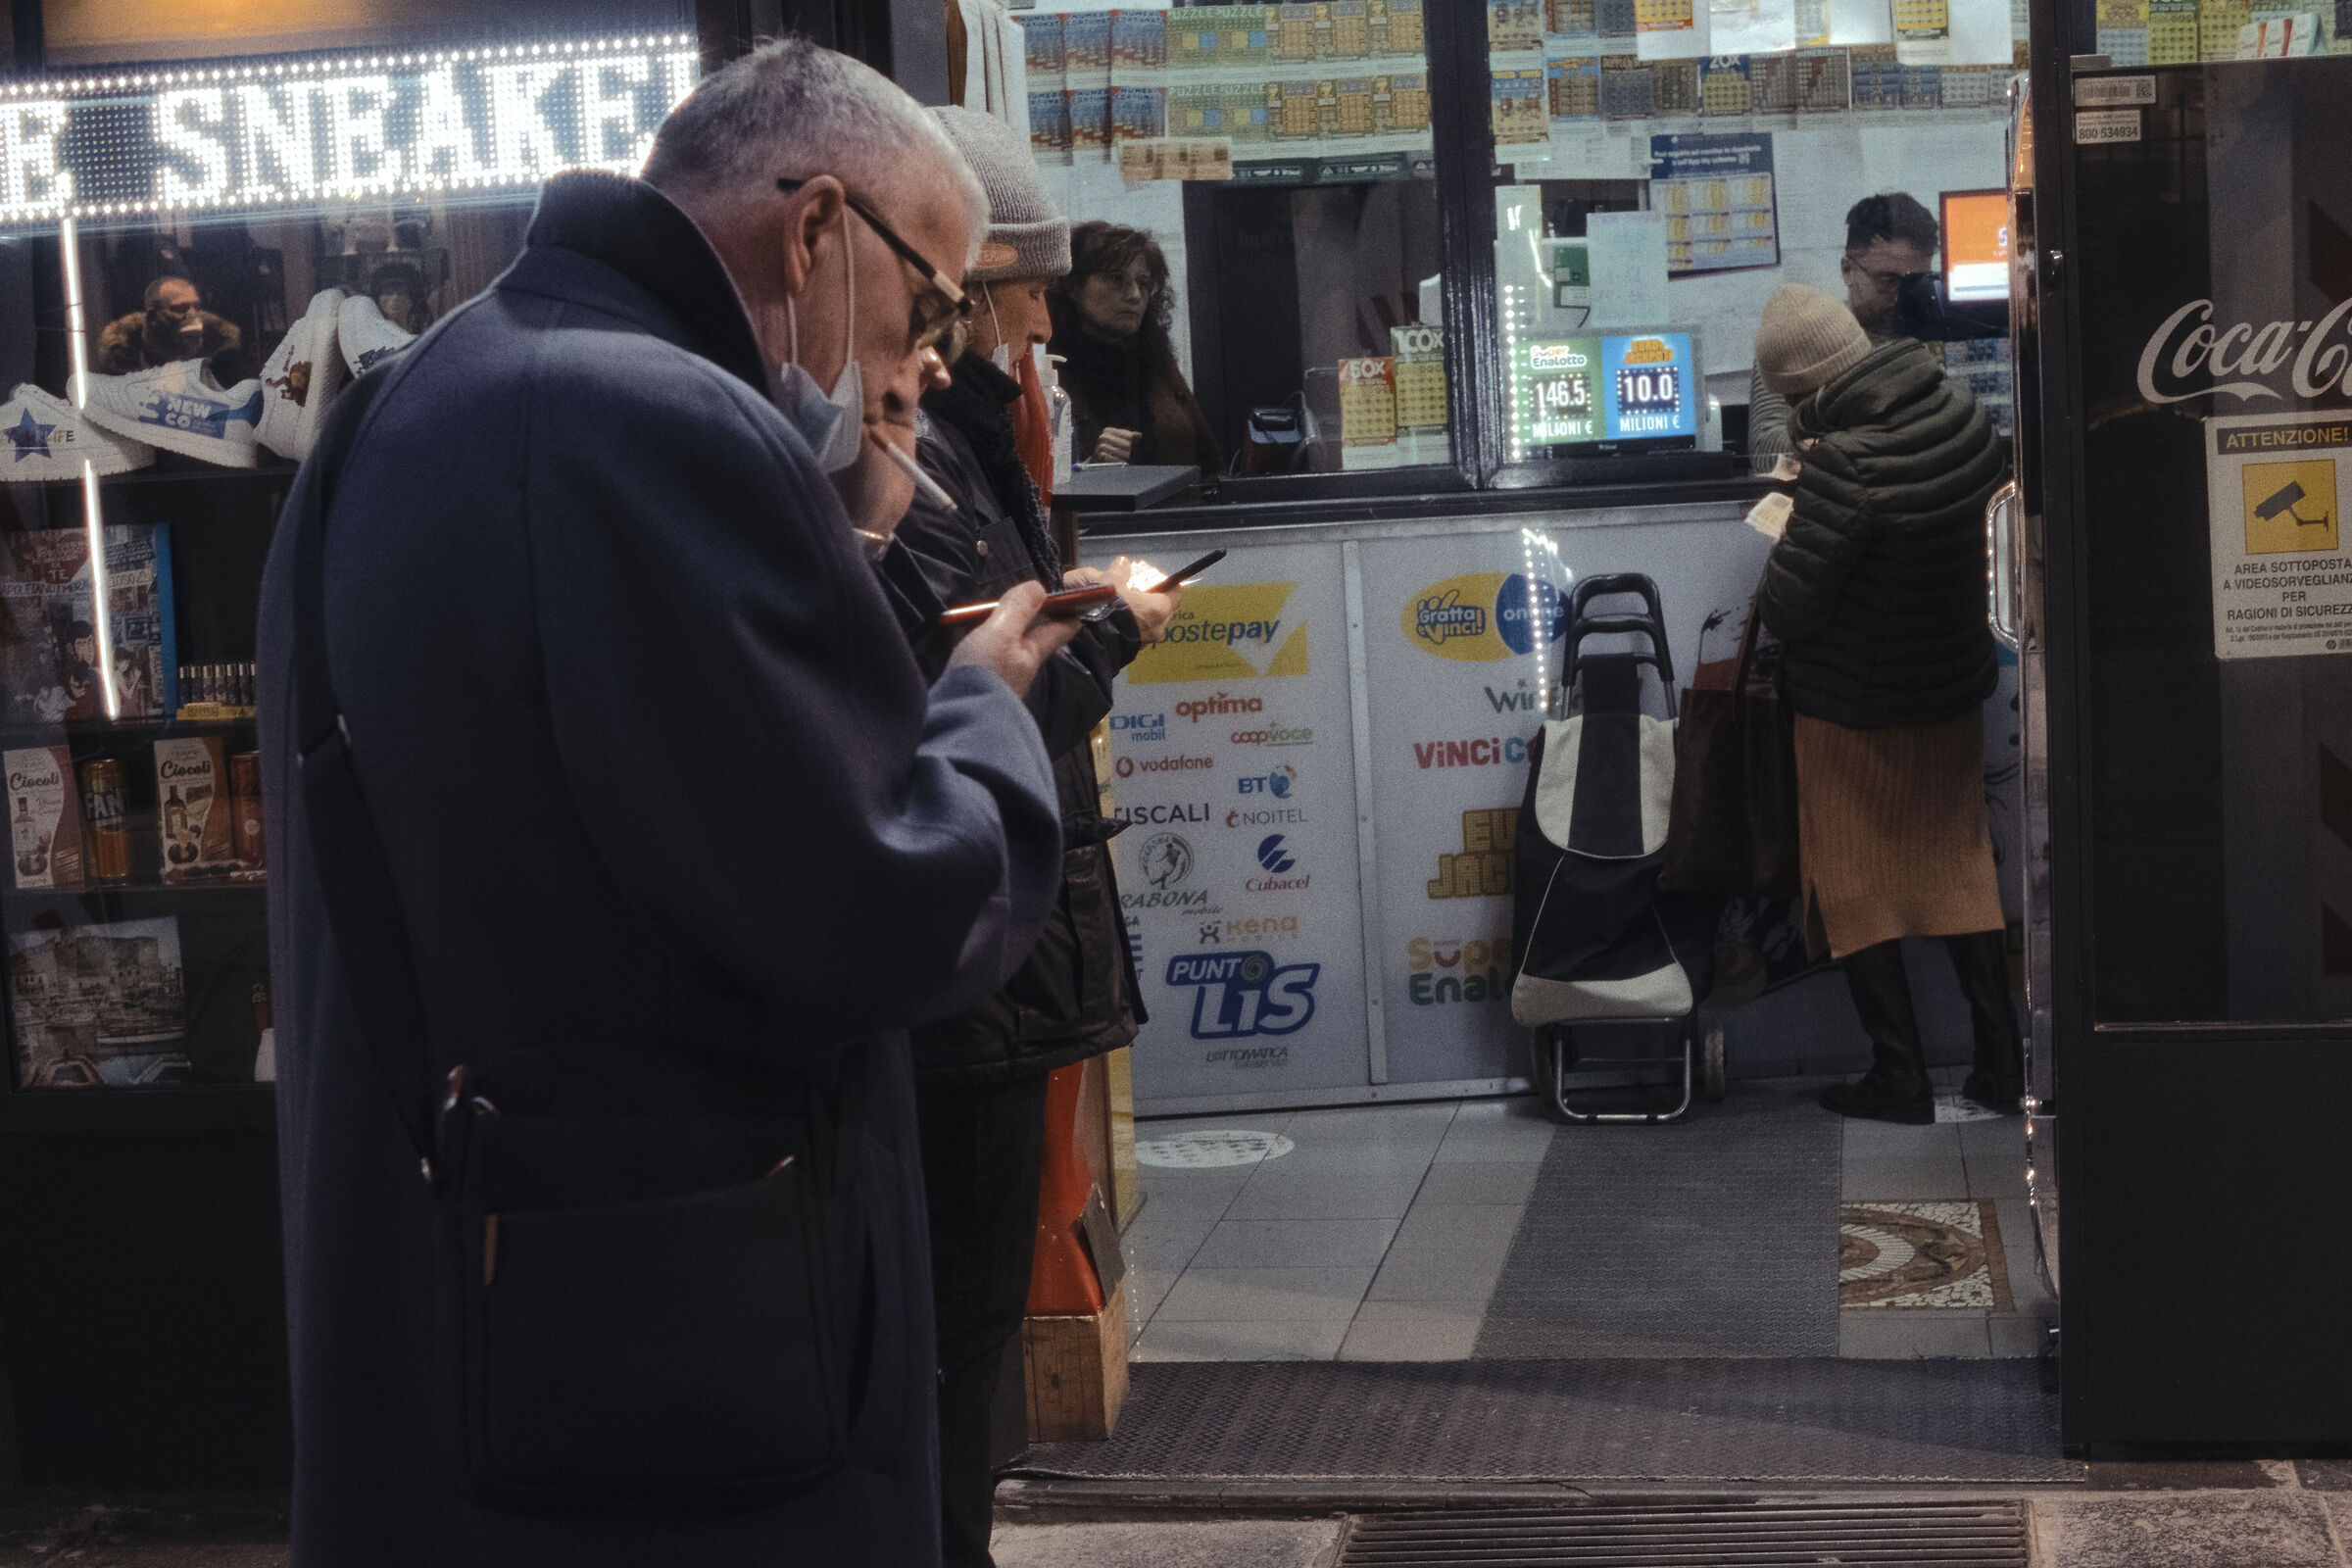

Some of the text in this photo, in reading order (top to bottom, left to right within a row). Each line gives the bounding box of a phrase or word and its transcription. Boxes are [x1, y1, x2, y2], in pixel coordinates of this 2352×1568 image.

[2079, 126, 2138, 139] 800 534934
[1533, 355, 1585, 368] Enalotto
[1536, 379, 1587, 408] 146.5
[1624, 373, 1674, 403] 10.0
[167, 396, 212, 417] NEW
[1585, 420, 1593, 434] €
[1619, 416, 1681, 432] MILIONI €
[2226, 425, 2349, 449] ATTENZIONE!
[2234, 559, 2352, 574] AREA SOTTOPOSTA
[2223, 580, 2231, 590] A
[2282, 591, 2307, 603] PER
[1419, 608, 1476, 623] Gratta
[1503, 606, 1564, 622] onne
[2228, 609, 2278, 620] RAGIONI
[2281, 607, 2292, 618] DI
[1176, 691, 1262, 723] optima
[1109, 713, 1165, 730] DIGI
[1132, 729, 1165, 742] mobil
[1140, 755, 1213, 772] vodafone
[1238, 776, 1267, 794] BT
[84, 787, 126, 819] FAN
[1114, 803, 1209, 825] TISCALI
[1246, 874, 1311, 892] Cubacel
[1120, 889, 1208, 909] RABONA
[1181, 906, 1223, 916] mobile
[1408, 937, 1513, 973] Supe
